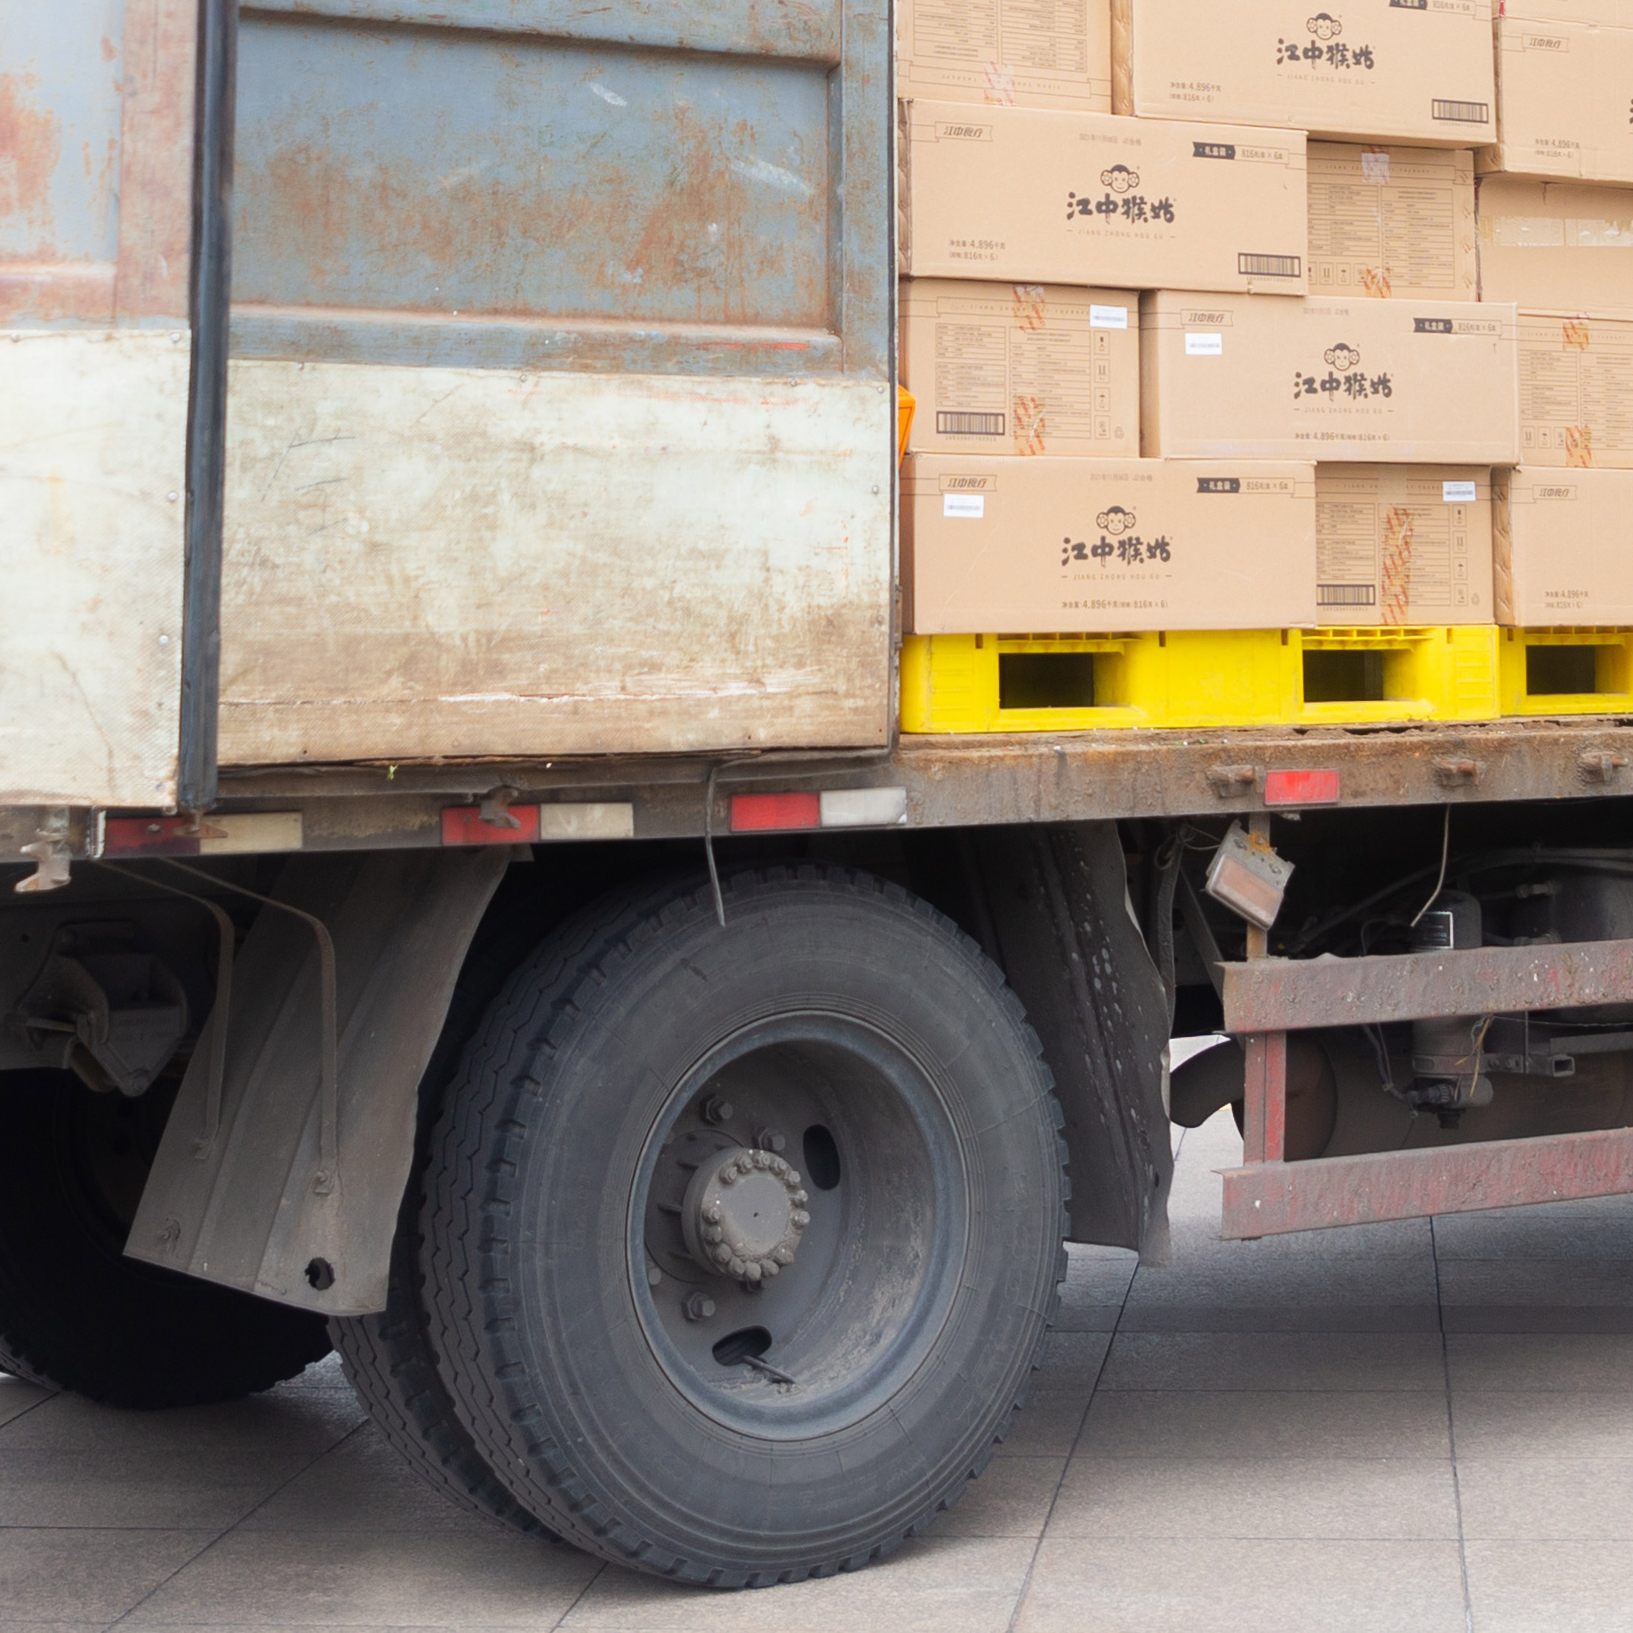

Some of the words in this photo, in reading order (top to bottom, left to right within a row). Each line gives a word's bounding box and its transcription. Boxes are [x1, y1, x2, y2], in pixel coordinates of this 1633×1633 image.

[1275, 37, 1375, 70] 江中猴姑
[1066, 191, 1175, 225] 江中猴姑
[1078, 228, 1102, 237] JIANG
[1104, 230, 1131, 239] ZHONG
[1133, 231, 1151, 240] HOU
[1153, 232, 1164, 240] GU
[1293, 370, 1393, 403] 江中猴姑
[1061, 534, 1172, 569] 江中猴姑
[1072, 572, 1097, 581] JIANG
[1099, 572, 1128, 581] ZHONG
[1130, 572, 1147, 581] HOU
[1149, 572, 1161, 581] GU
